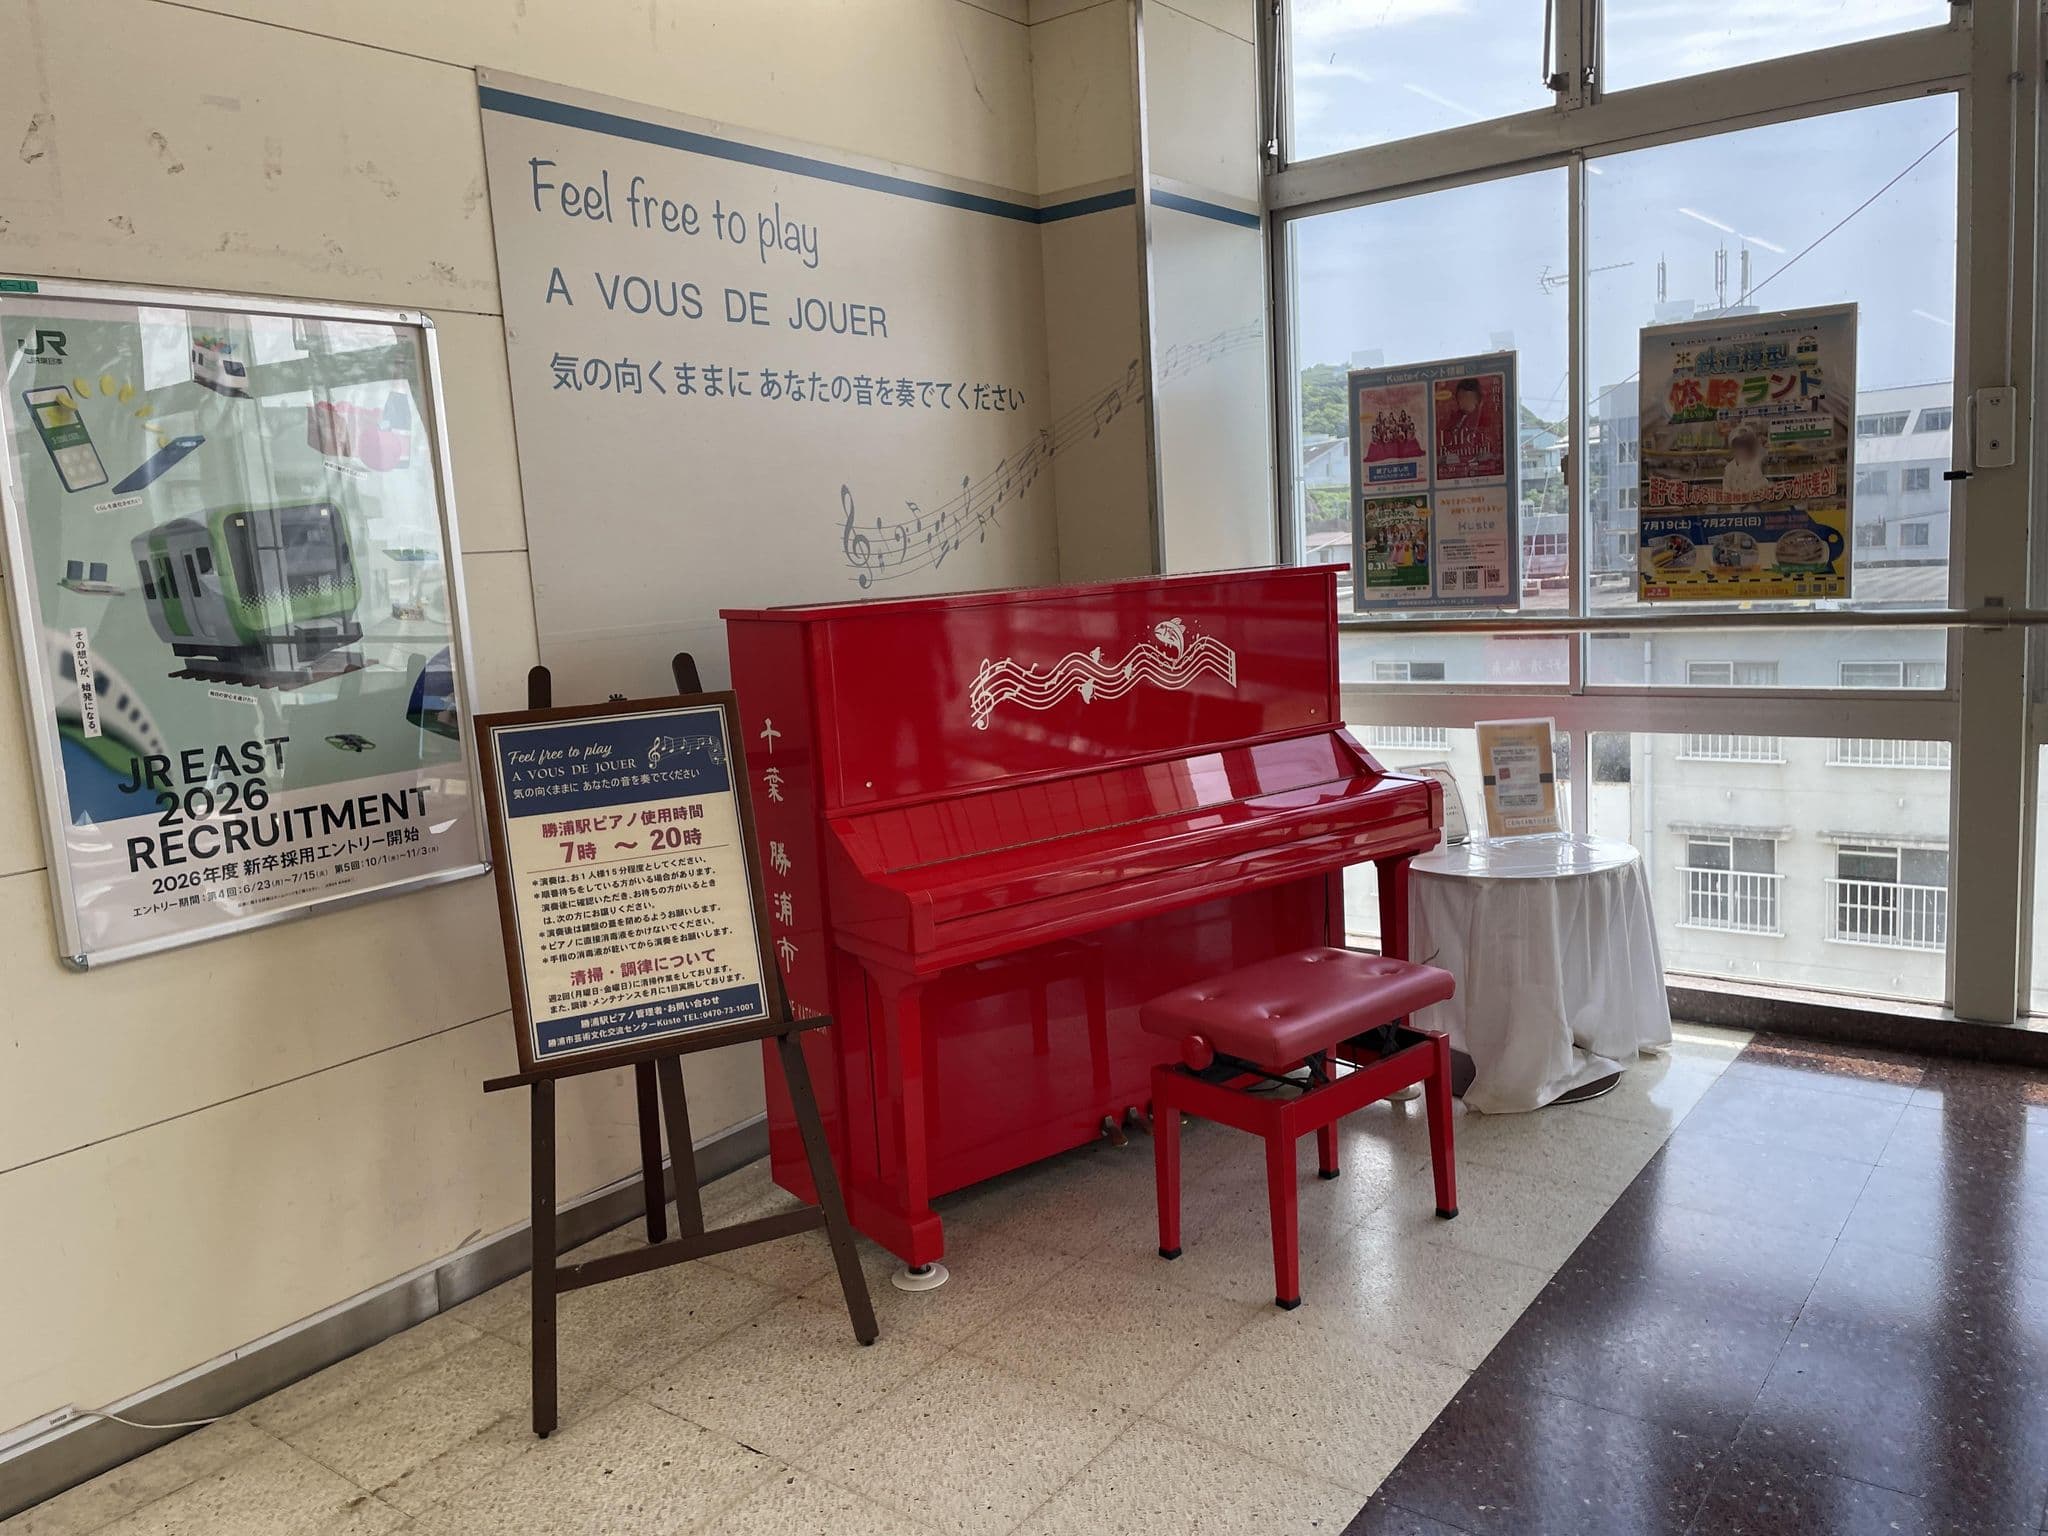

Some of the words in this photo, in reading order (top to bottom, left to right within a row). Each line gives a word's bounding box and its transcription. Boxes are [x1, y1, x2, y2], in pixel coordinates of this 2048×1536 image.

[528, 157, 613, 223] Feel
[626, 176, 700, 236] free
[712, 200, 747, 244] to
[757, 202, 819, 269] play
[545, 267, 574, 306] A
[594, 272, 703, 319] VOUS
[724, 288, 770, 326] DE
[789, 297, 888, 338] JOUER
[17, 329, 68, 356] JR
[549, 352, 752, 397] 気の向くままに
[760, 367, 1026, 412] あなたの音を奏でてください
[118, 754, 174, 793] JR
[181, 736, 290, 784] EAST
[508, 749, 535, 765] Feel
[538, 748, 563, 765] free
[568, 745, 580, 758] to
[584, 743, 613, 760] play
[512, 771, 522, 782] A
[527, 766, 565, 780] VOUS
[571, 764, 589, 776] DE
[594, 759, 637, 774] JOUER
[155, 777, 269, 827] 2026
[513, 783, 579, 800] 気の向くままに
[582, 769, 700, 791] あなたの音を奏でてください
[127, 785, 431, 873] RECRUITMENT
[541, 804, 704, 838] 勝浦駅ピアノ使用時間
[559, 841, 597, 863] 7時
[649, 827, 702, 851] 20時
[152, 863, 239, 894] 2026年度
[243, 826, 420, 876] 新卒採用エントリー開始
[769, 841, 799, 973] 勝浦市
[570, 948, 716, 986] 清掃・調律について
